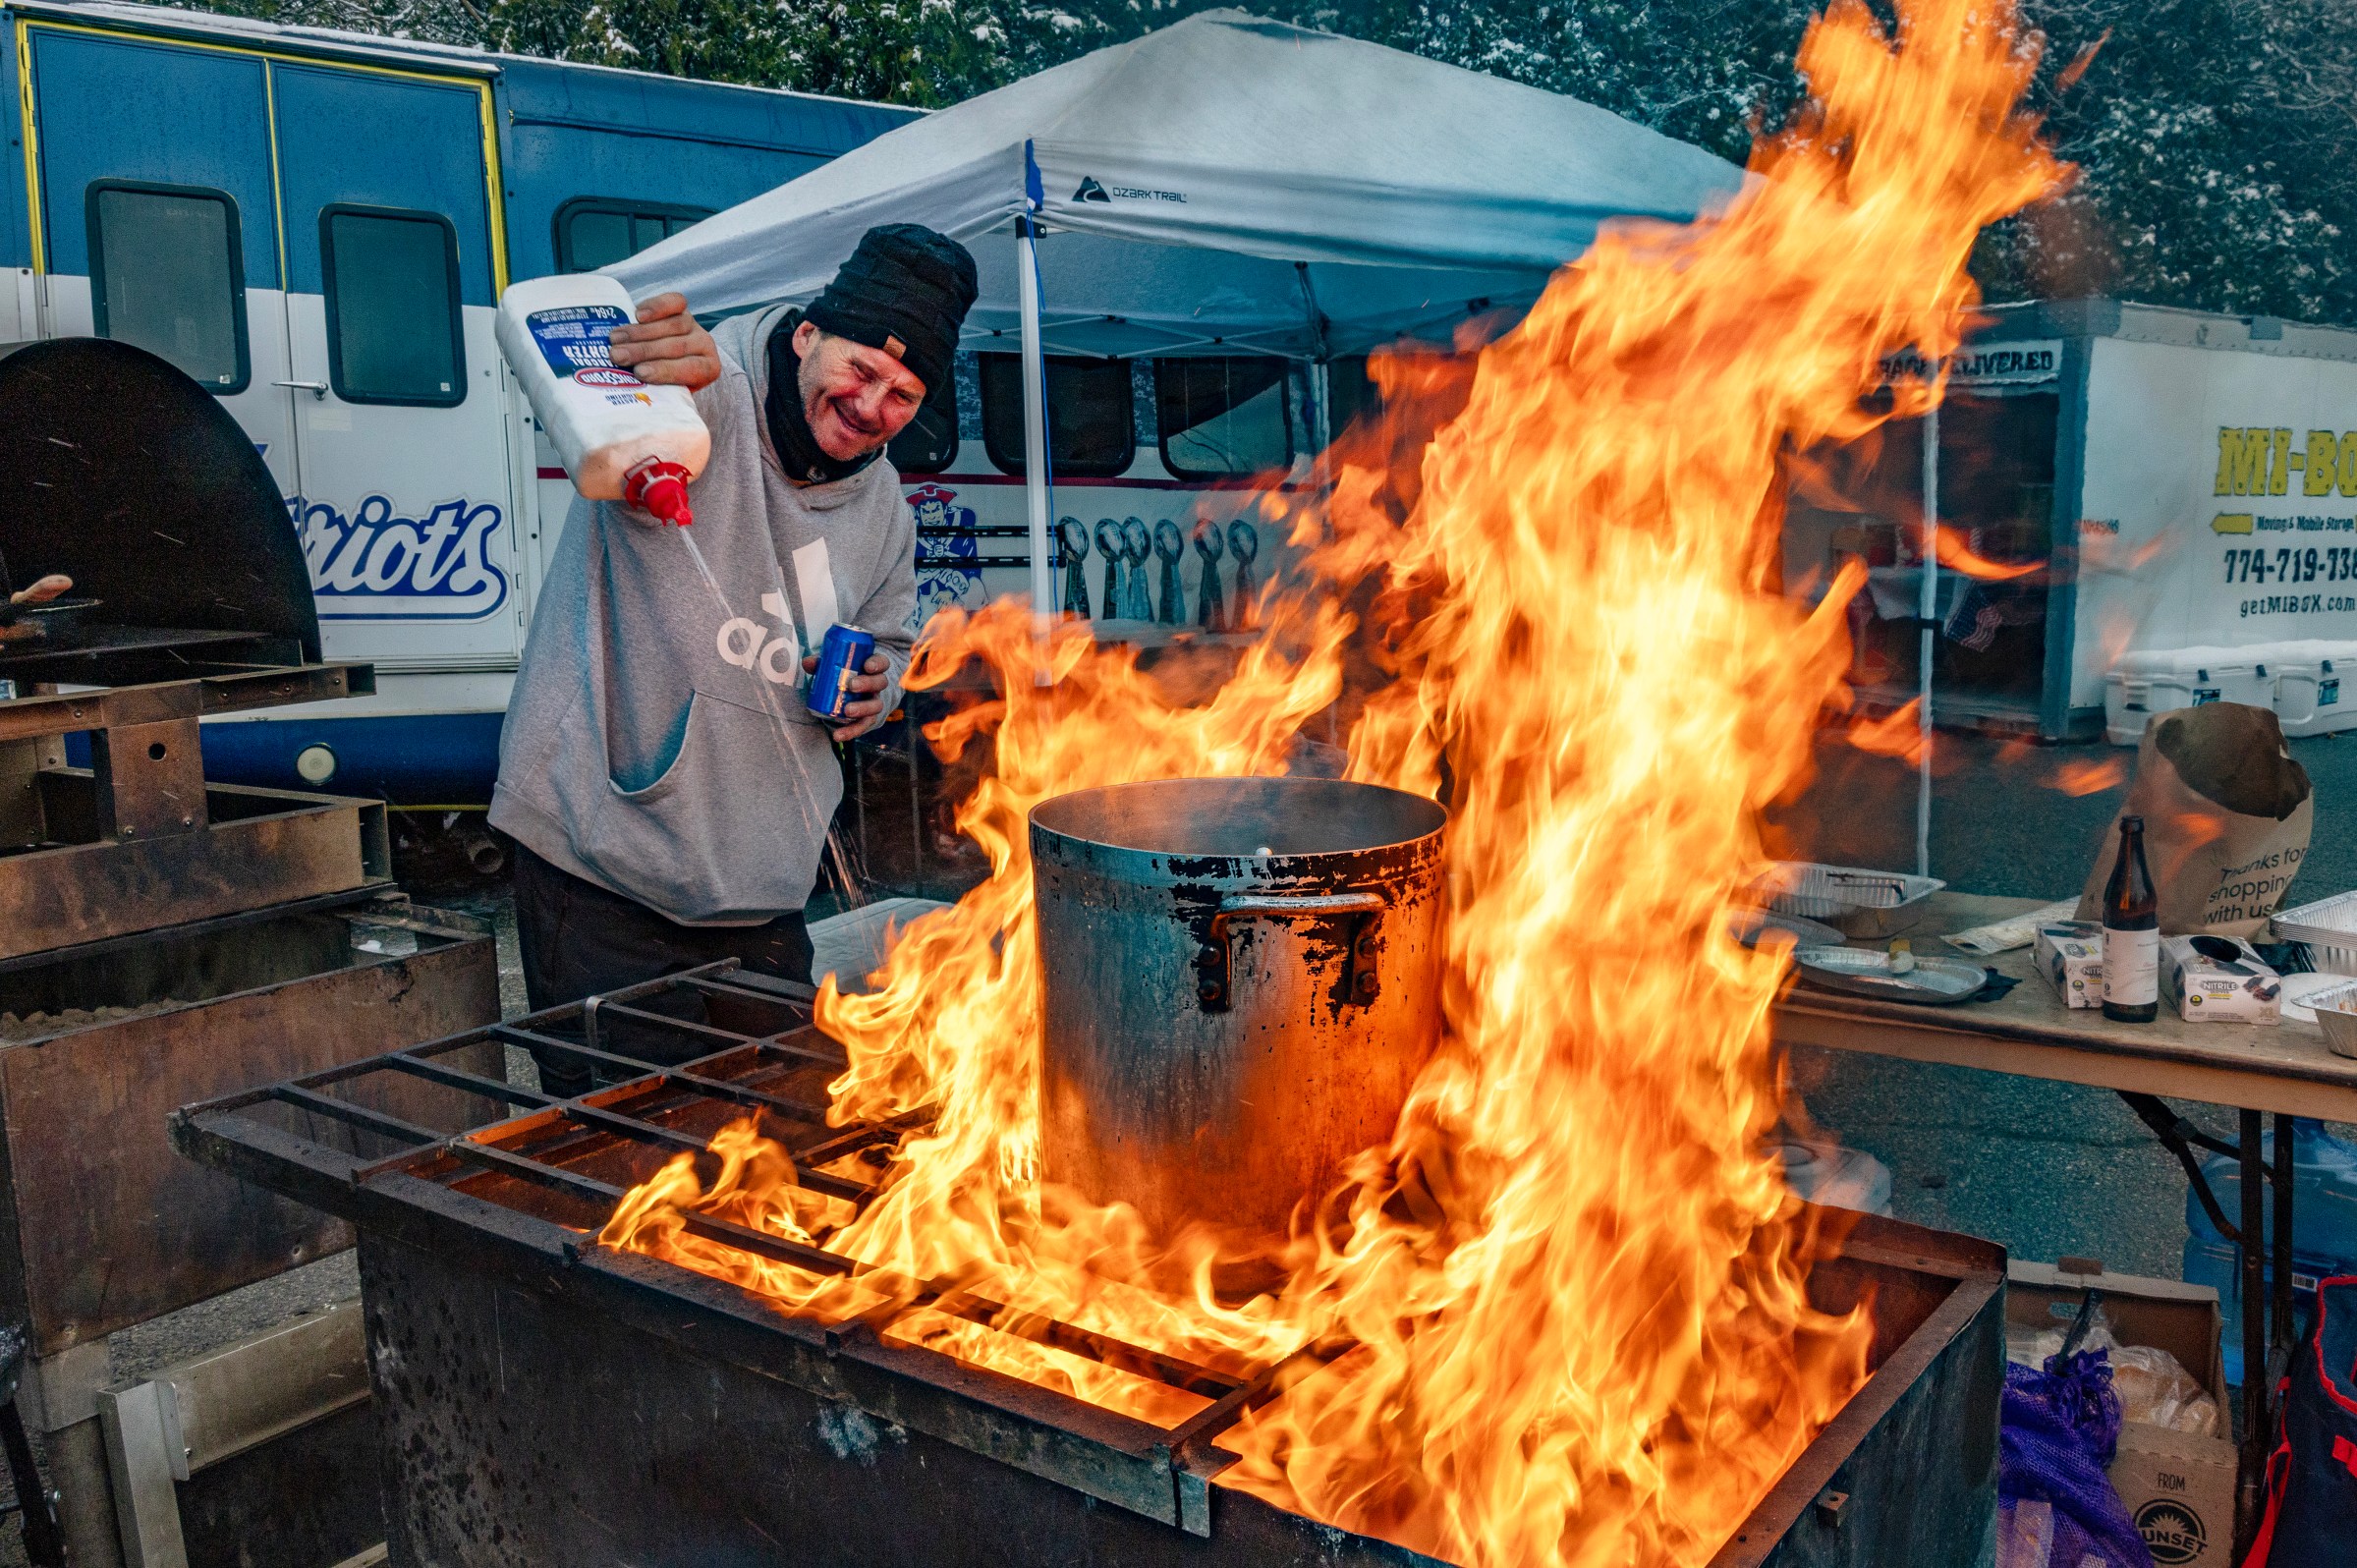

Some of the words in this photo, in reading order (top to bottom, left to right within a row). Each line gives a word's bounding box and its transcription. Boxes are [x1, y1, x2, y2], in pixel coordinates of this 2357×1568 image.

[569, 358, 615, 368] ARCOAL
[582, 370, 642, 386] KINGSFORD
[2257, 515, 2287, 532] Moving
[2297, 515, 2325, 532] Mobile
[2220, 853, 2280, 883] Thanks
[2203, 904, 2243, 924] with
[2249, 903, 2273, 919] us
[2083, 967, 2104, 976] NITR
[2202, 981, 2237, 990] NITRILE
[2158, 1472, 2186, 1491] FROM
[2142, 1529, 2209, 1555] UNSET
